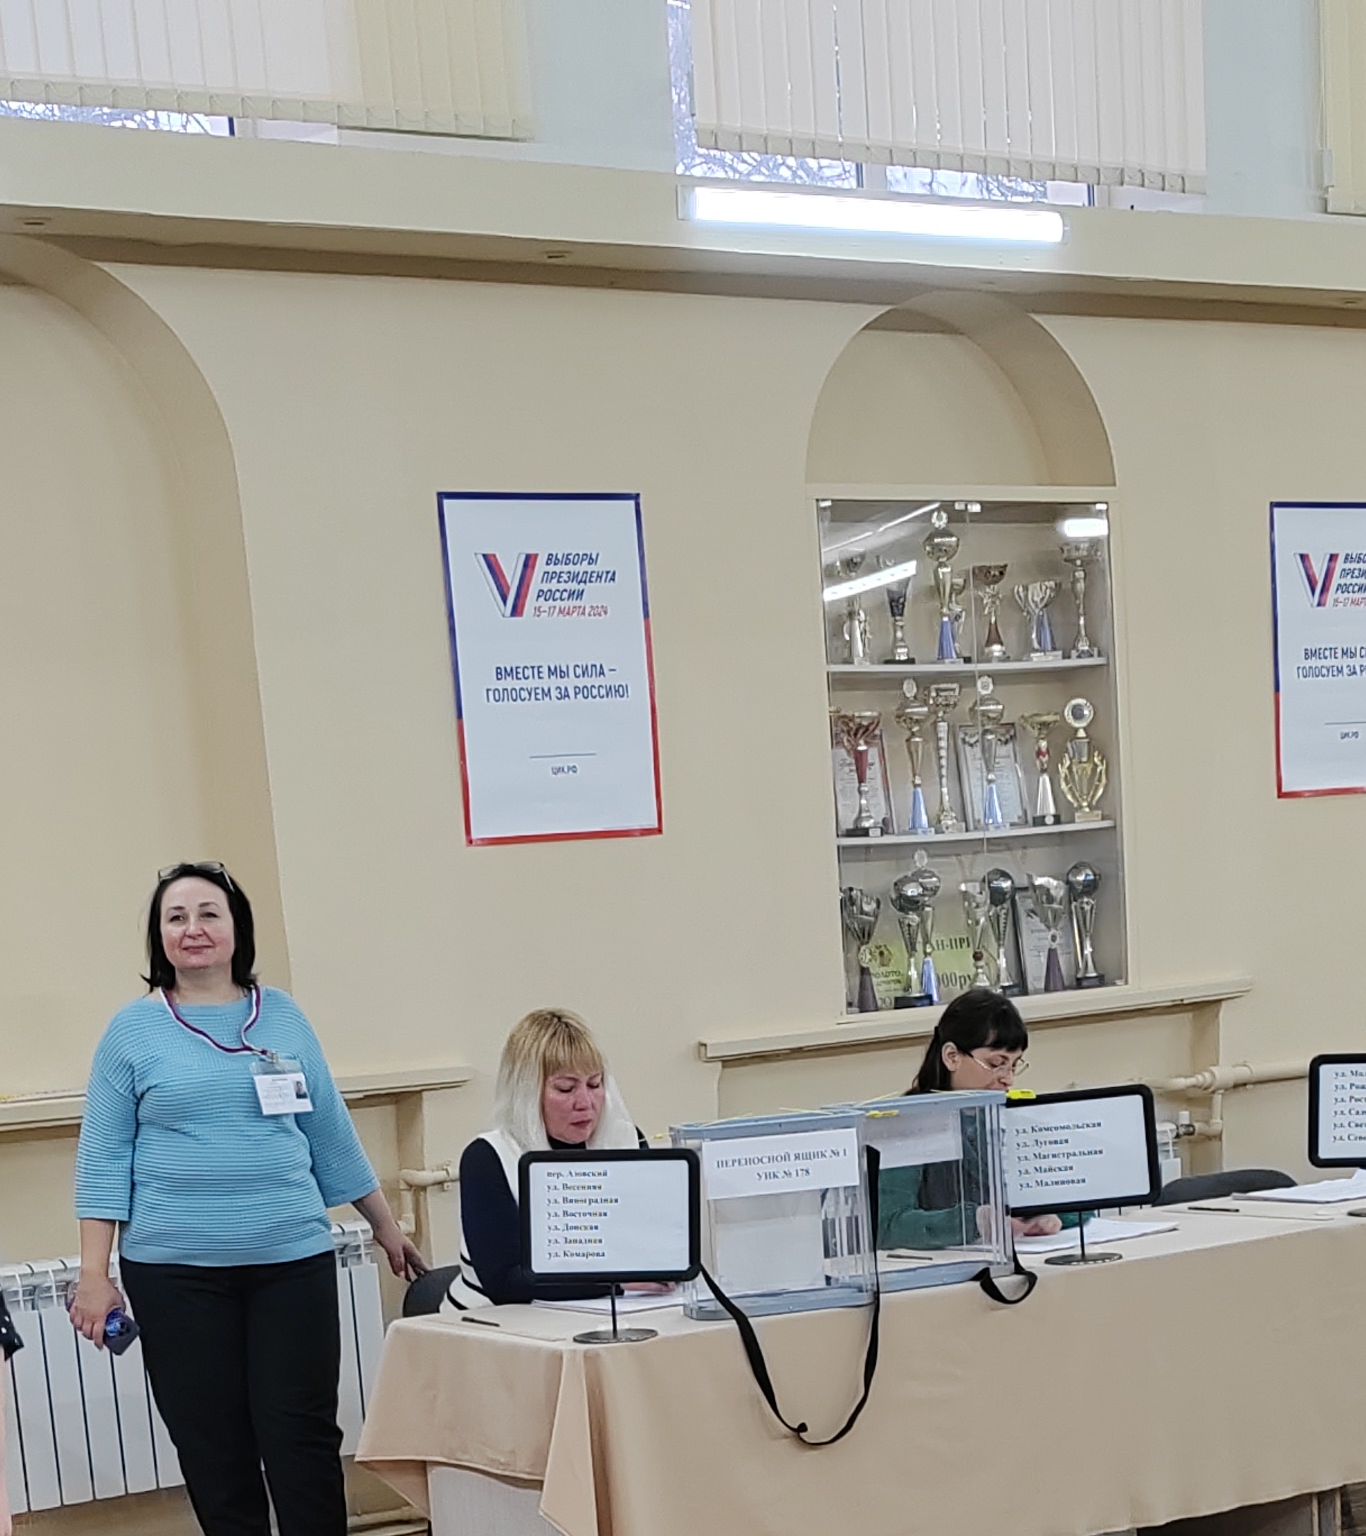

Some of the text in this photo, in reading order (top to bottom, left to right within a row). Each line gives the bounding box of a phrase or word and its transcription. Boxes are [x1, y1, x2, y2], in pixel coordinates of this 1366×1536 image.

[545, 552, 599, 566] ВЫБОРЫ
[540, 570, 616, 585] ПРЕЗИДЕНТА
[535, 588, 585, 602] РОССИИ
[557, 605, 586, 617] МАРТА
[588, 604, 608, 617] 2024
[1304, 647, 1338, 661] ВМЕСТЕ
[1341, 646, 1357, 659] МЫ
[495, 665, 544, 681] ВМЕСТЕ
[547, 664, 570, 680] МЫ
[573, 663, 606, 679] СИЛА
[1296, 664, 1344, 679] ГОЛОСУЕМ
[1346, 664, 1358, 677] ЗА
[486, 684, 629, 703] ГОЛОСУЕМ ЗА РОССИЮ!
[1334, 1071, 1347, 1079] ул.
[1334, 1084, 1347, 1092] ул.
[1334, 1097, 1347, 1105] ул.
[1333, 1110, 1346, 1118] ул.
[1031, 1121, 1102, 1133] Комсомольская
[1333, 1123, 1346, 1131] ул.
[1032, 1138, 1069, 1149] Луговая
[716, 1148, 847, 1168] ПЕРЕНОСНОЙ ЯЩИК № 1
[1033, 1149, 1104, 1161] Магистральная
[757, 1168, 810, 1181] УИК № 178
[1033, 1164, 1074, 1174] Майская
[547, 1171, 564, 1179] пер.
[547, 1183, 602, 1192] ул. Весенняя
[1035, 1176, 1086, 1188] Малиновая
[547, 1196, 619, 1205] ул. Виноградная
[547, 1210, 608, 1219] ул. Восточная
[547, 1223, 599, 1232] ул. Донская
[547, 1237, 603, 1246] ул. Западная
[548, 1250, 605, 1260] ул. Комарова
